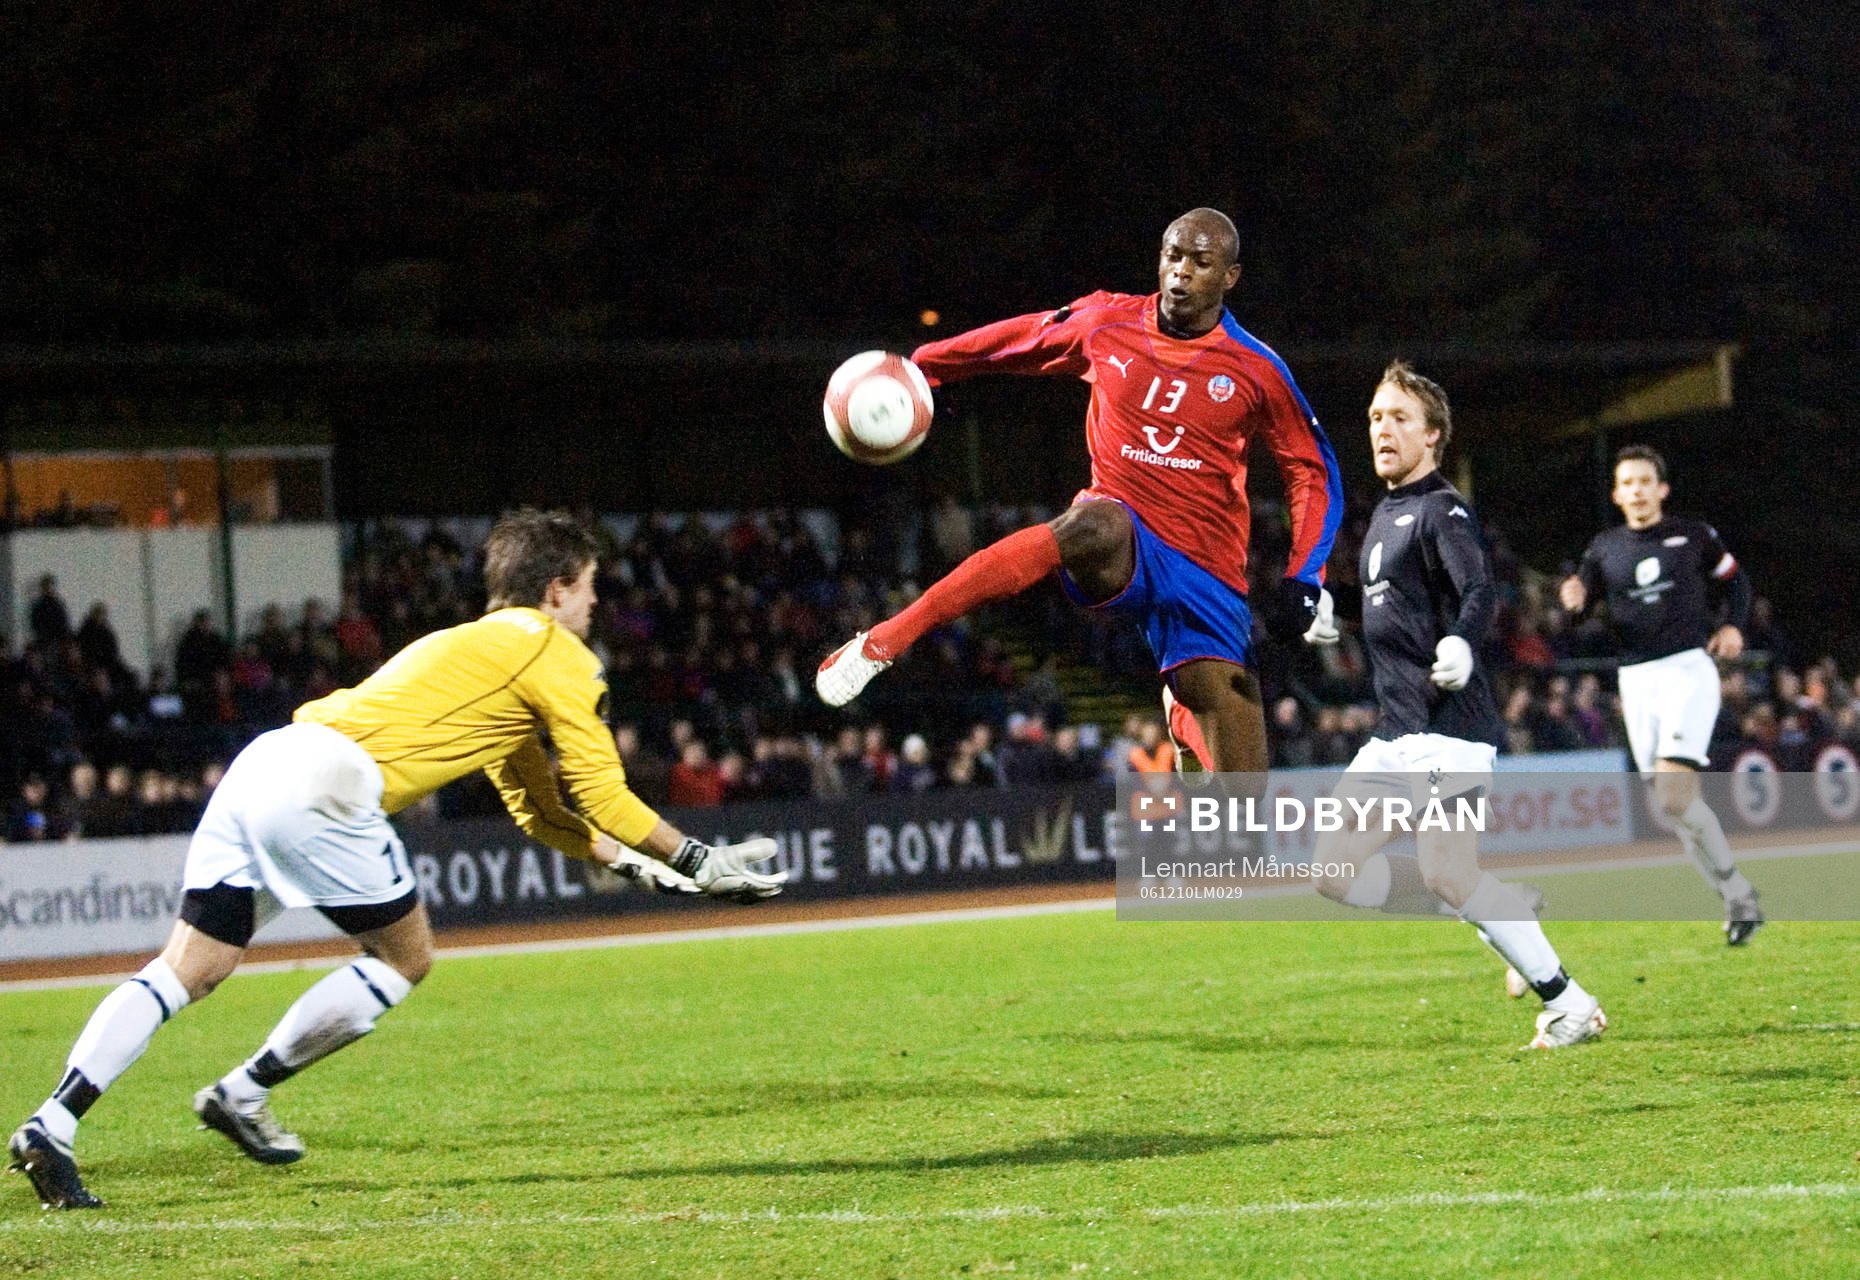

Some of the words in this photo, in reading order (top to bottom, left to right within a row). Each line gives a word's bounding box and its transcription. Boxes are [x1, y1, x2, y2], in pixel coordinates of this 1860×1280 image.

[1141, 376, 1188, 414] 13
[1121, 444, 1202, 470] Fritidsresor
[382, 839, 403, 885] 1
[865, 813, 1022, 877] ROYAL
[413, 848, 584, 905] ROYAL
